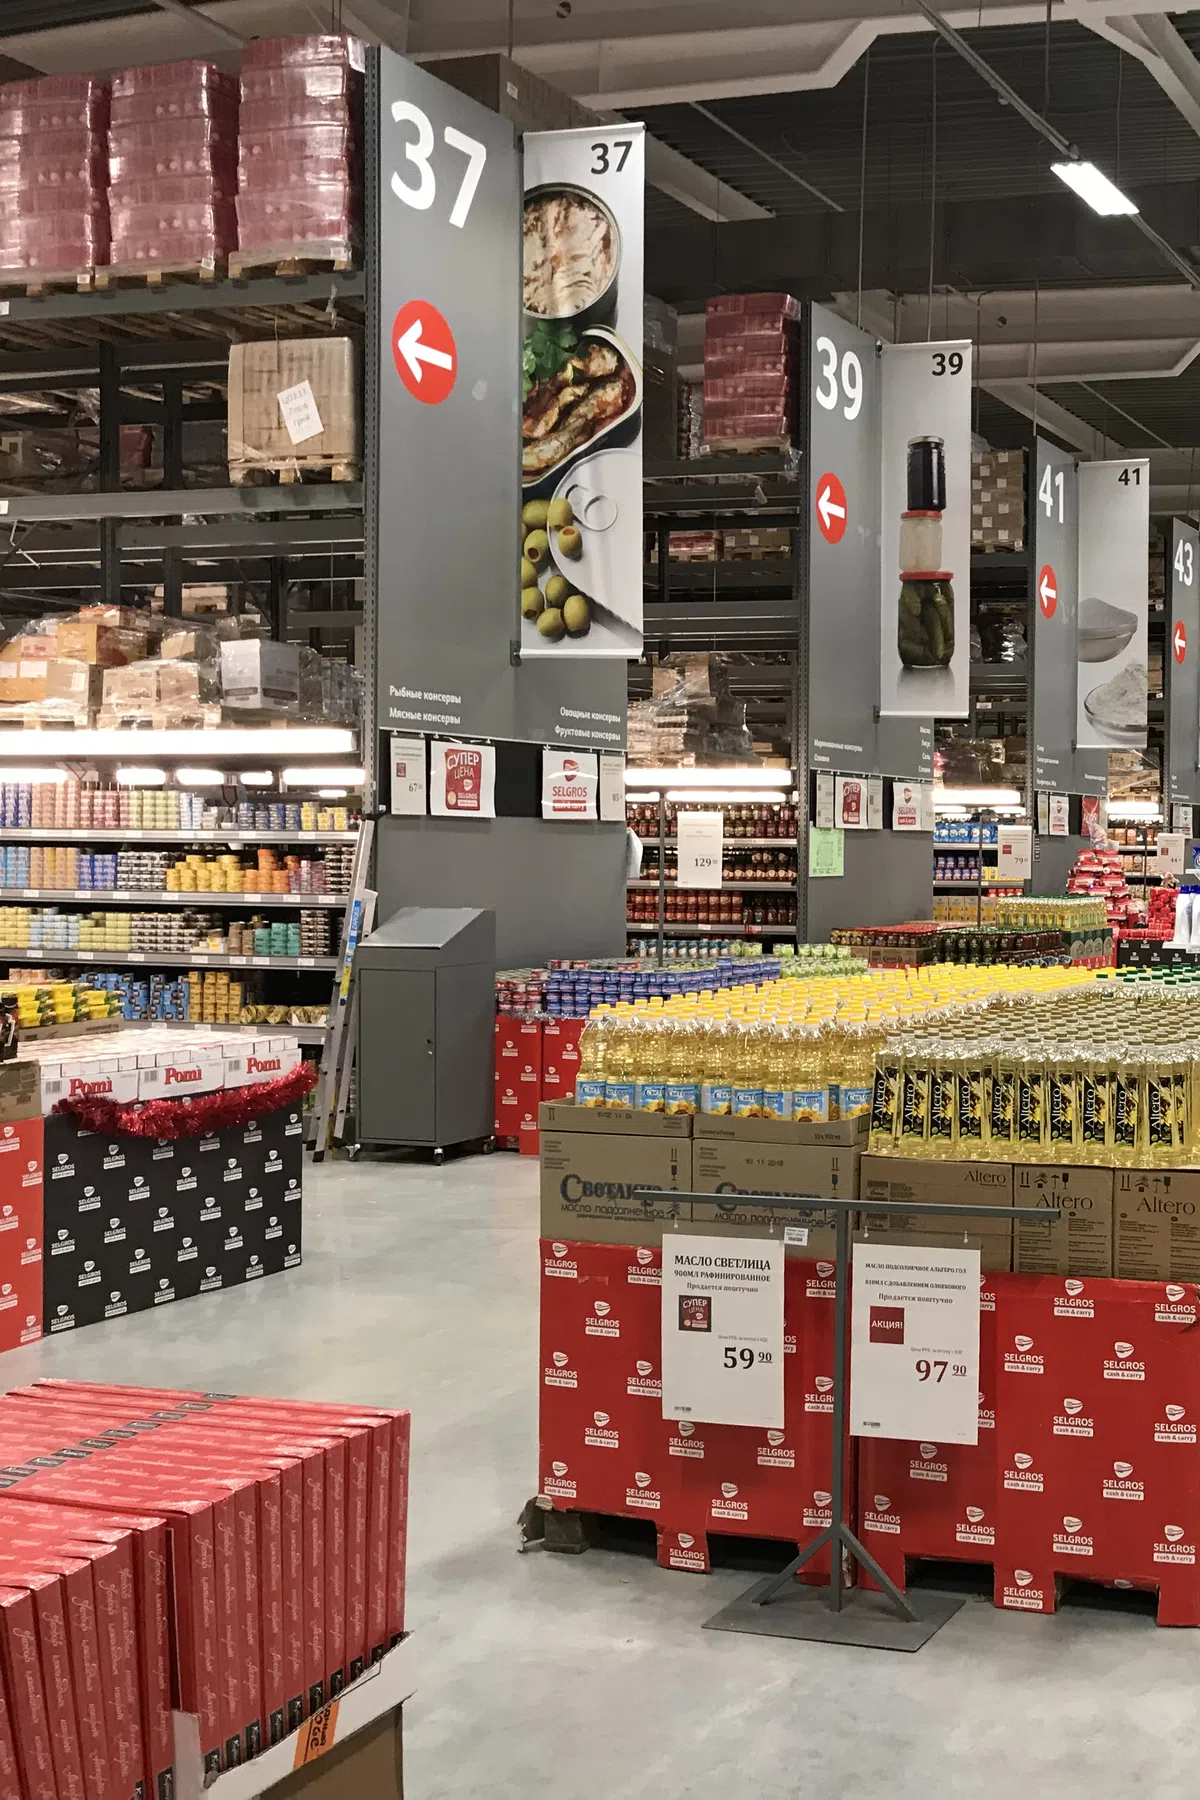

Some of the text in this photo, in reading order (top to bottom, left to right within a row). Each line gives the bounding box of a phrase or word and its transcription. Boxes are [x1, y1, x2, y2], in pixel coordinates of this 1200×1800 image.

[590, 141, 633, 174] 37
[390, 100, 487, 229] 37
[931, 352, 963, 377] 39
[815, 336, 864, 421] 39
[1118, 467, 1141, 486] 41
[1038, 463, 1065, 524] 41
[1173, 538, 1193, 586] 43
[389, 685, 461, 704] Рыбные консервы
[389, 707, 460, 725] Мясные консервы
[560, 706, 621, 723] Овощные консервы
[555, 725, 621, 741] Фруктовые консервы
[446, 751, 480, 770] СУПЕР
[454, 767, 475, 779] ЦЕНА
[552, 786, 588, 798] SELGROS
[694, 858, 712, 867] 129
[246, 1055, 281, 1074] Pomì
[164, 1065, 202, 1085] Pomì
[874, 1080, 886, 1124] Altero
[904, 1084, 914, 1128] Altero
[932, 1085, 942, 1129] Altero
[961, 1085, 971, 1129] Altero
[1021, 1088, 1030, 1133] Altero
[1052, 1088, 1062, 1133] Altero
[1085, 1089, 1095, 1134] Altero
[1151, 1091, 1162, 1137] Altero
[964, 1170, 1007, 1183] Altero
[1036, 1192, 1093, 1209] Altero
[1137, 1197, 1196, 1215] Altero
[561, 1203, 591, 1213] масло
[545, 1259, 577, 1269] SELGROS
[674, 1255, 771, 1271] МАСЛО СВЕТЛИЦА
[628, 1266, 662, 1276] SELGROS
[674, 1270, 771, 1282] 900МЛ РАФИНИРОВАННОЕ
[686, 1282, 722, 1292] Продается
[806, 1280, 836, 1288] SELGR
[683, 1299, 707, 1309] СУПЕР
[878, 1293, 953, 1304] Продается поштучно
[1054, 1298, 1094, 1308] SELGROS
[1155, 1303, 1196, 1313] SELGROS
[585, 1318, 620, 1328] SELGROS
[871, 1320, 903, 1330] АКЦИЯ!
[723, 1347, 772, 1370] 59 90
[1004, 1353, 1044, 1364] SELGROS
[1103, 1360, 1145, 1370] SELGROS
[915, 1360, 967, 1383] 97 90
[1053, 1416, 1094, 1427] SELGROS
[1154, 1423, 1197, 1433] SELGROS
[757, 1447, 795, 1458] SELGROS
[910, 1460, 947, 1472] SELGROS
[1103, 1480, 1144, 1490] SELGROS
[712, 1499, 748, 1511] SELGROS
[956, 1524, 995, 1535] SELGROS
[670, 1549, 705, 1560] SELGROS
[1154, 1543, 1195, 1553] SELGROS
[1004, 1587, 1043, 1598] SELGROS
